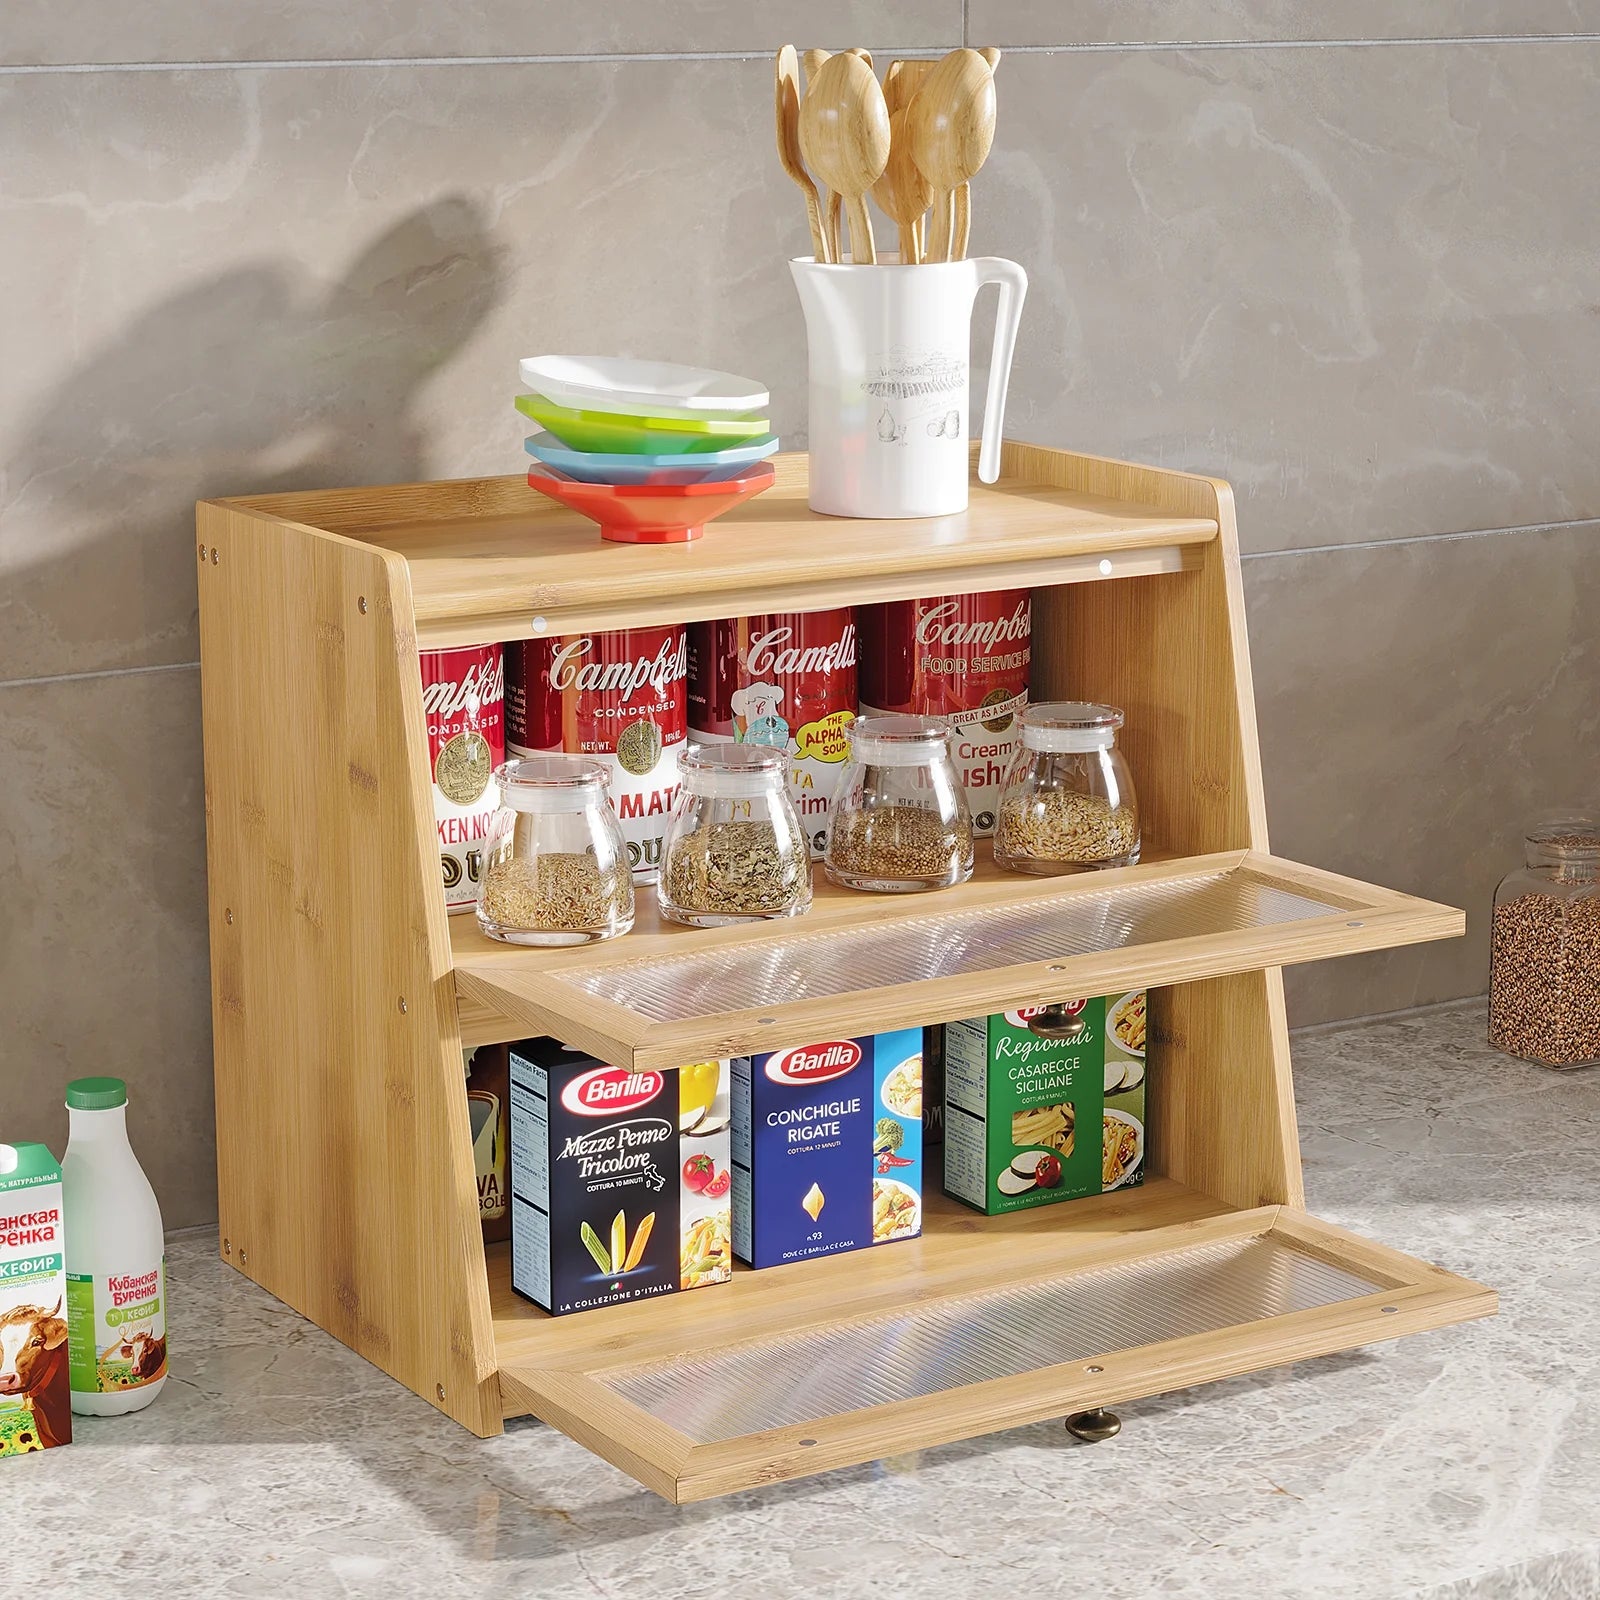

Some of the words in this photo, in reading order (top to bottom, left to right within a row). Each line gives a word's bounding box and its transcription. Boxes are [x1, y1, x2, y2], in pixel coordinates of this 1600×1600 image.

[921, 655, 968, 675] FOOD
[970, 651, 1023, 674] SERVICE
[595, 700, 676, 718] CONDENSED
[953, 711, 979, 724] GREAT
[981, 709, 991, 721] AS
[993, 706, 999, 715] A
[428, 714, 499, 736] ONDENSED
[826, 715, 842, 727] THE
[581, 742, 596, 751] NET
[805, 730, 844, 749] ALPHA
[822, 741, 847, 756] SOUP
[958, 741, 1012, 760] Cream
[788, 1045, 854, 1073] Barilla
[1008, 1057, 1080, 1080] CASARECCE
[586, 1072, 655, 1103] Barilla
[1016, 1074, 1073, 1094] SICILIANE
[766, 1098, 861, 1126] CONCHIGLIE
[788, 1121, 841, 1143] RIGATE
[560, 1136, 616, 1160] Mezze
[617, 1127, 669, 1149] Penne
[787, 1145, 814, 1155] COTTURA
[821, 1140, 841, 1149] MINUTI
[577, 1149, 651, 1178] Tricolore
[8, 1172, 58, 1188] НАТУРАЛЬНЫЙ
[586, 1182, 615, 1193] COTTURA
[615, 1180, 622, 1188] 10
[622, 1176, 644, 1186] MINUTI
[806, 1231, 823, 1241] n.93
[782, 1250, 798, 1259] DOVE
[808, 1244, 829, 1254] BARILLA
[838, 1240, 855, 1248] CASA
[0, 1256, 55, 1277] КЕФИР
[108, 1271, 158, 1291] Кубанская
[113, 1283, 157, 1306] Бурёнка
[560, 1304, 571, 1312] LA
[575, 1292, 632, 1309] COLLEZIONE
[127, 1303, 155, 1320] КЕФИР
